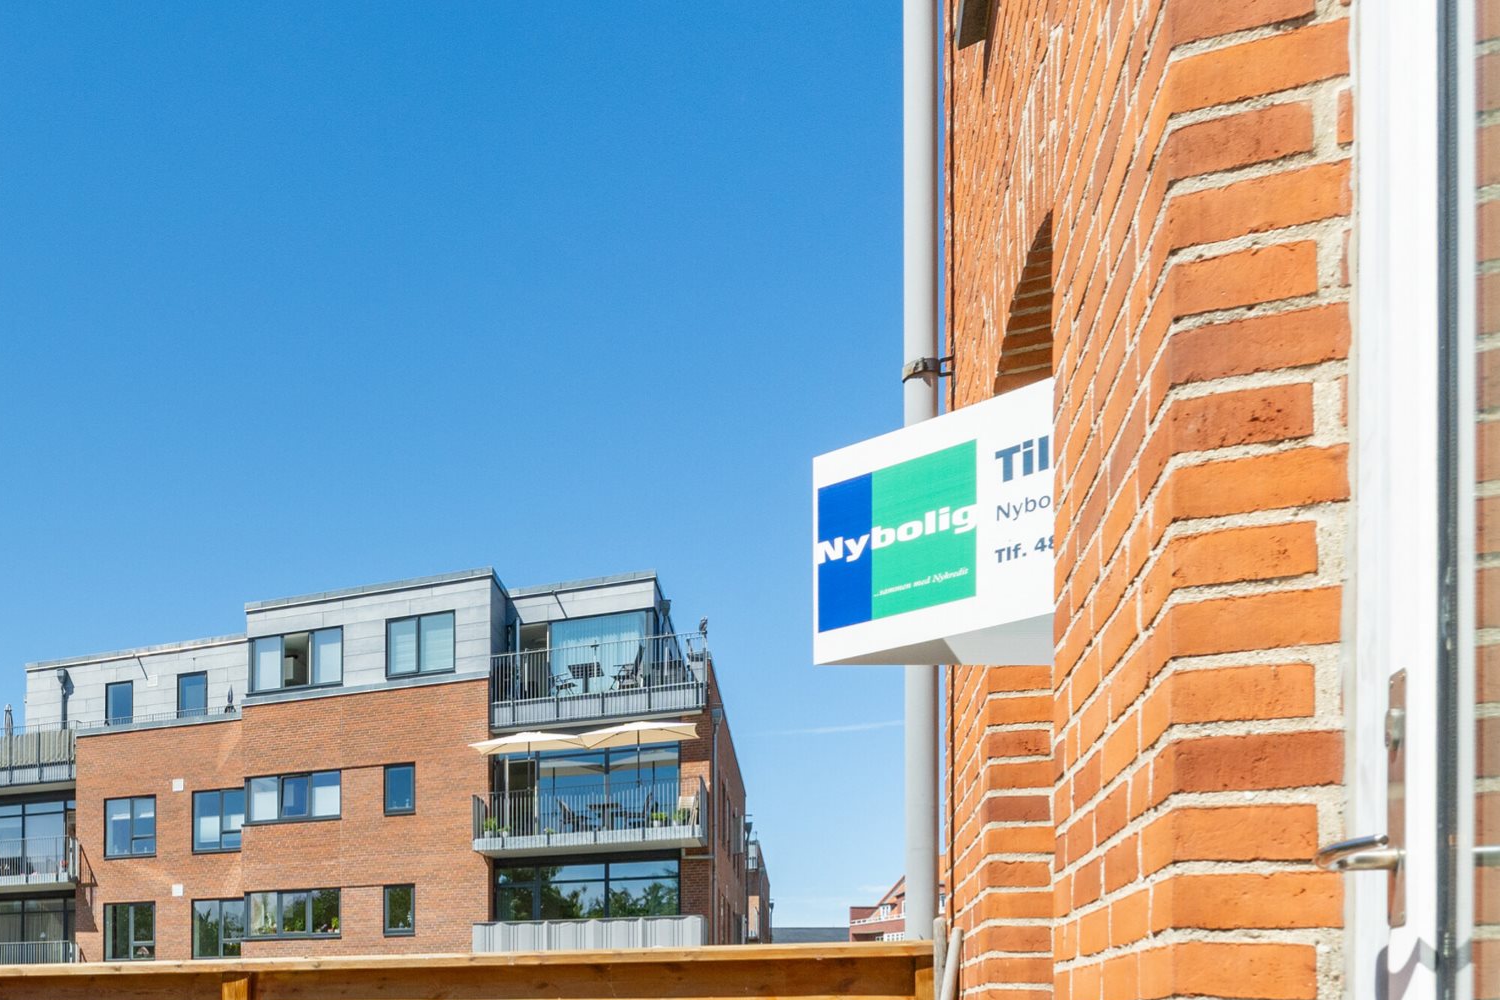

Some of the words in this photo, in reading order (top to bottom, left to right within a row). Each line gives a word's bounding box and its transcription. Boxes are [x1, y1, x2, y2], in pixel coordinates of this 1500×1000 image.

[995, 435, 1049, 483] Til
[996, 495, 1051, 521] Nybo
[817, 503, 978, 565] Nybolig
[994, 543, 1027, 563] Tlf.
